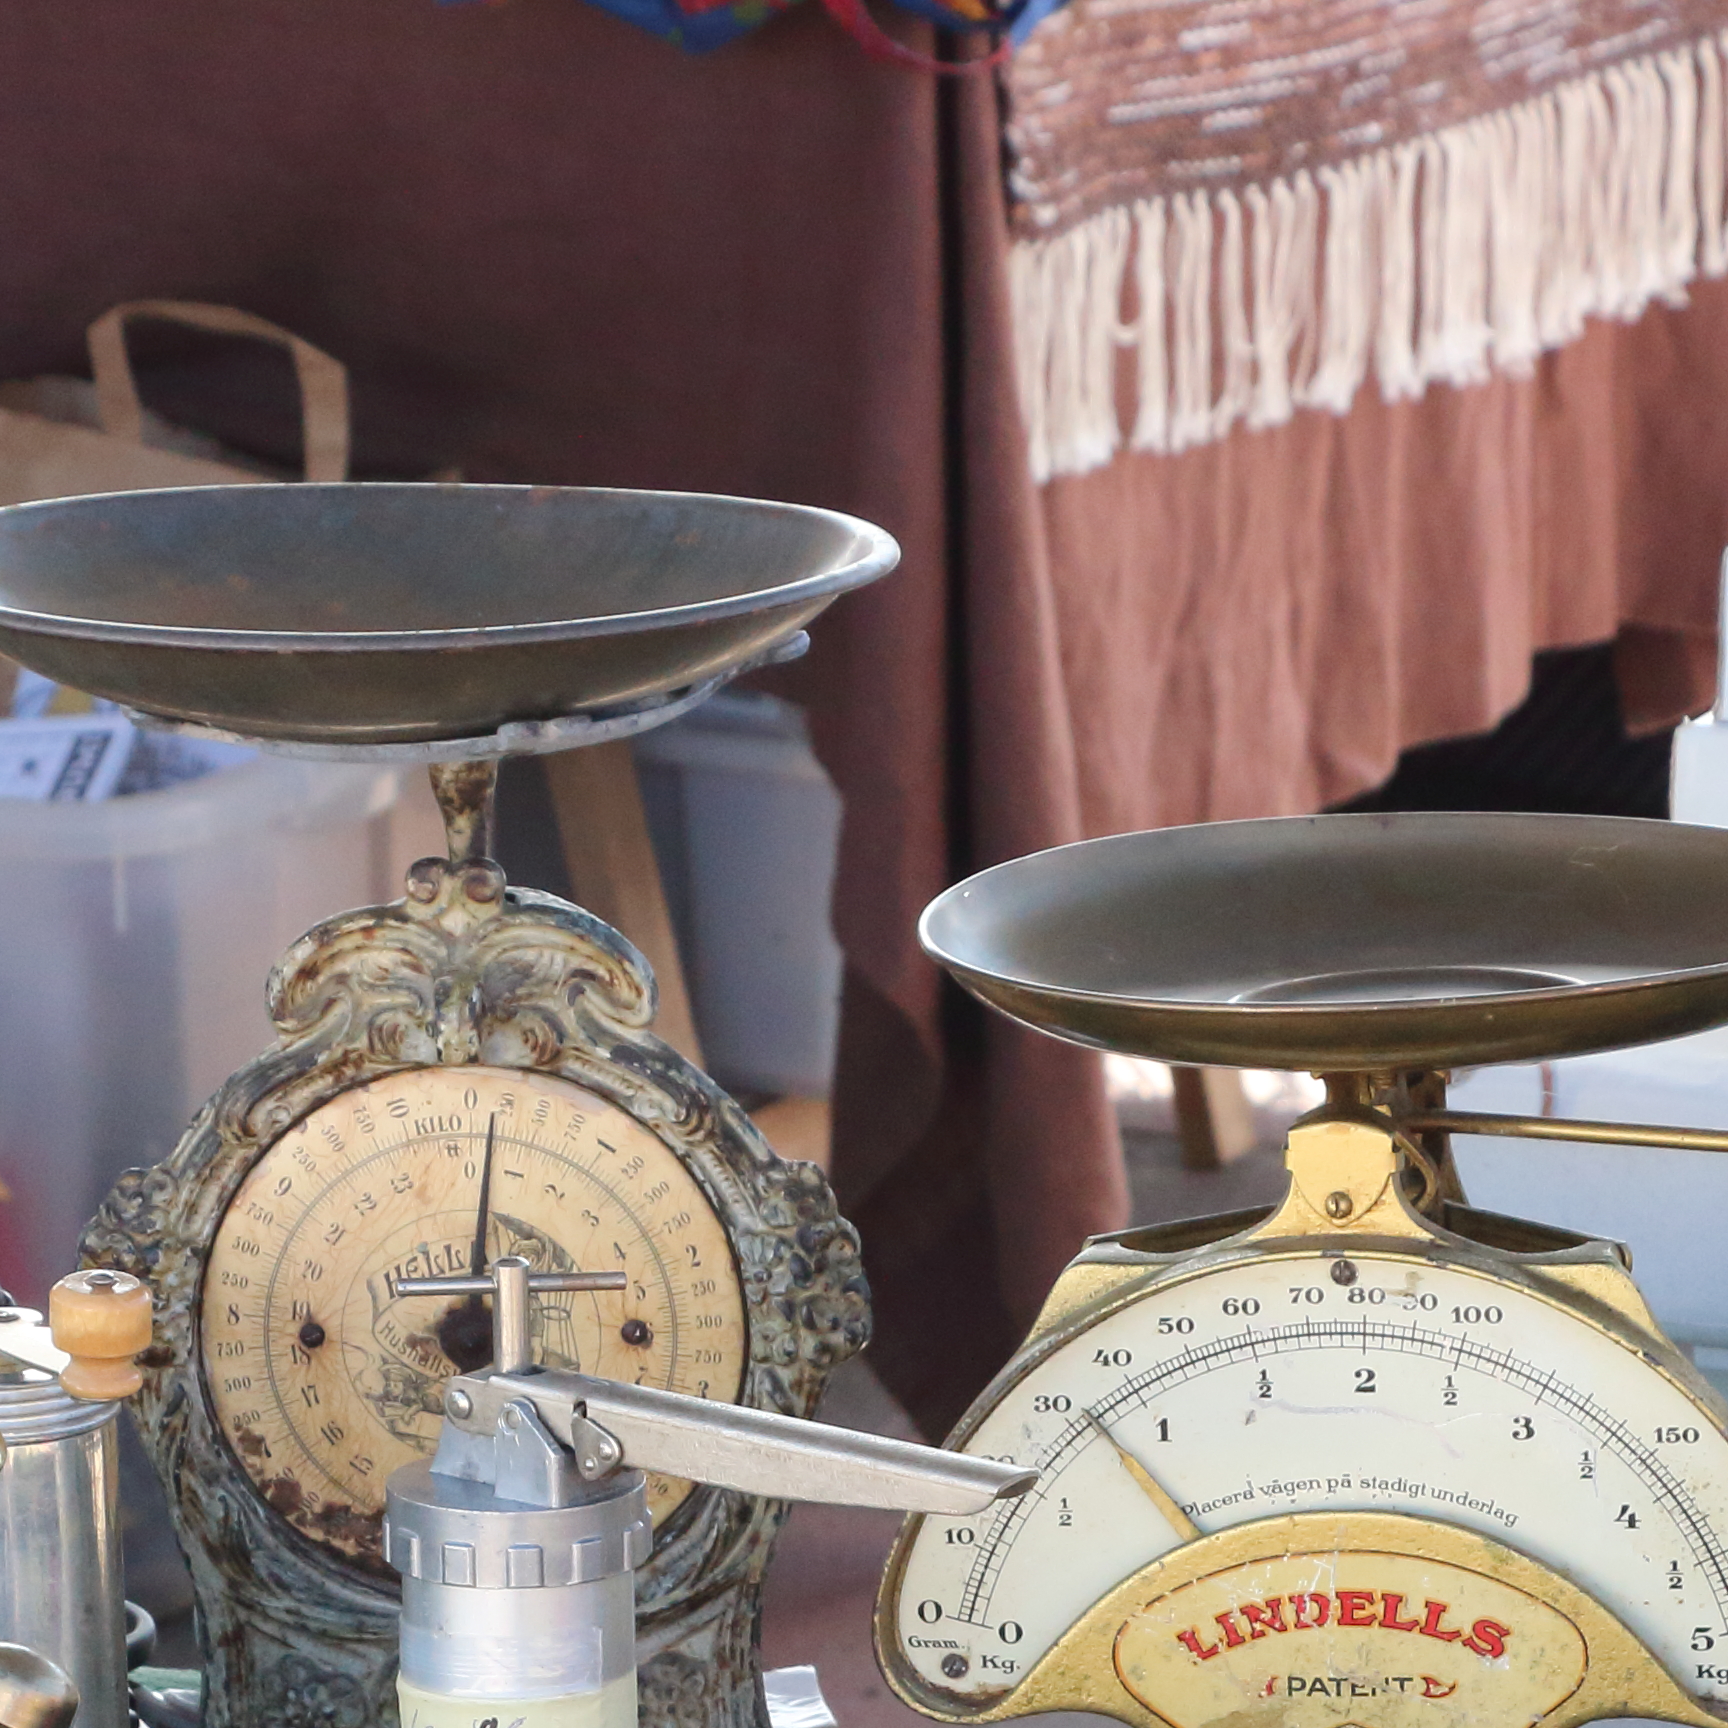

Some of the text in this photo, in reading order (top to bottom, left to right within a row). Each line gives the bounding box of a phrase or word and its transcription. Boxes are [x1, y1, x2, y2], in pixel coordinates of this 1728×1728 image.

[386, 1097, 410, 1119] 10
[464, 1088, 477, 1110] 0
[352, 1105, 375, 1134] 750
[414, 1114, 462, 1137] KILO
[321, 1124, 346, 1152] 500
[292, 1146, 317, 1173] 250
[463, 1161, 476, 1180] 0
[621, 1155, 645, 1180] 250
[273, 1176, 293, 1197] 9
[544, 1183, 566, 1200] 2
[643, 1181, 670, 1205] 500
[245, 1202, 274, 1227] 750
[581, 1209, 600, 1227] 3
[663, 1212, 691, 1235] 750
[322, 1221, 347, 1247] 21
[231, 1236, 260, 1257] 500
[613, 1242, 626, 1261] 4
[685, 1244, 701, 1268] 2
[221, 1271, 249, 1288] 250
[301, 1259, 323, 1282] 20
[633, 1280, 646, 1301] 5
[691, 1280, 716, 1297] 250
[1288, 1286, 1326, 1305] 70
[1347, 1287, 1386, 1305] 80
[226, 1302, 240, 1326] 8
[1221, 1297, 1261, 1317] 60
[1450, 1305, 1503, 1324] 100
[696, 1315, 722, 1329] 500
[1158, 1317, 1195, 1335] 50
[216, 1340, 245, 1357] 750
[695, 1351, 722, 1365] 750
[1092, 1348, 1133, 1367] 40
[224, 1376, 252, 1393] 500
[1354, 1369, 1377, 1394] 2
[301, 1385, 321, 1409] 17
[1033, 1394, 1073, 1413] 30
[320, 1420, 345, 1446] 16
[1155, 1417, 1173, 1443] 1
[1511, 1416, 1536, 1441] 3
[1653, 1427, 1701, 1444] 150
[1181, 1487, 1255, 1517] Placera
[1359, 1476, 1427, 1498] stadigt
[1430, 1486, 1520, 1528] underlag
[1613, 1504, 1642, 1530] 4
[944, 1527, 975, 1545] 10
[917, 1599, 943, 1624] 0
[998, 1620, 1024, 1644] 0
[1176, 1591, 1512, 1660] LINDELLS
[1691, 1627, 1714, 1652] 5
